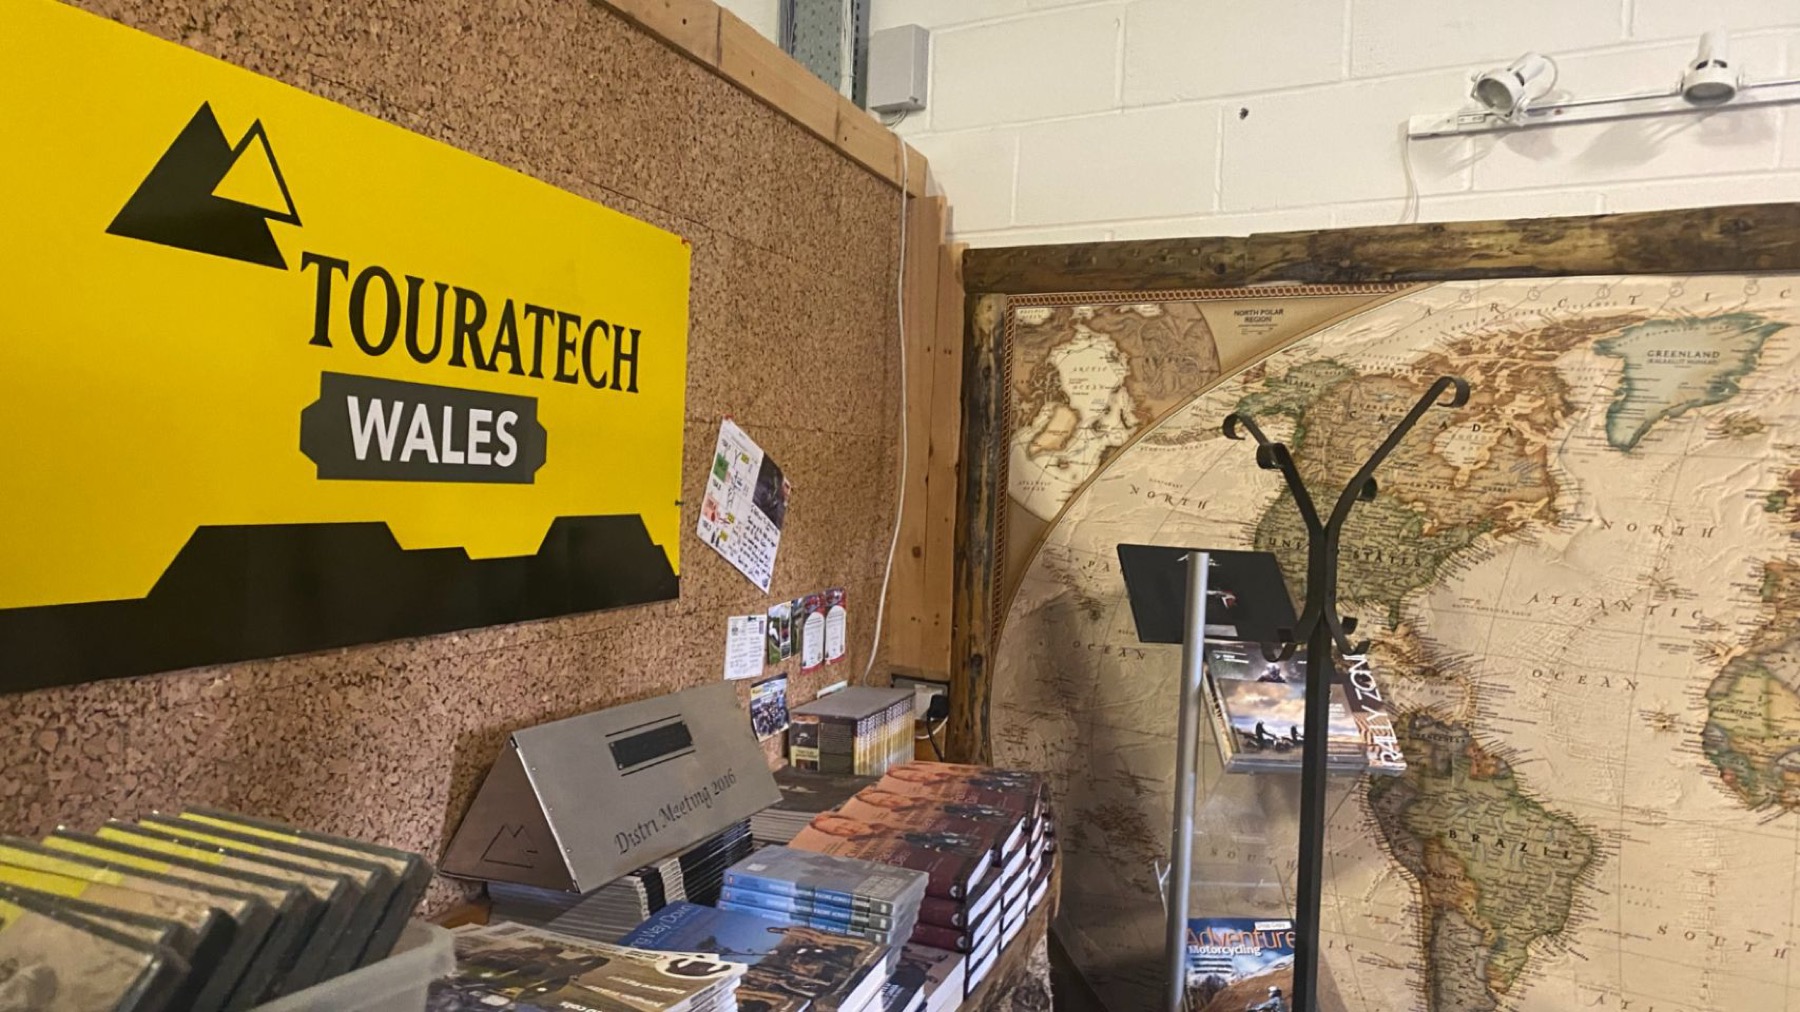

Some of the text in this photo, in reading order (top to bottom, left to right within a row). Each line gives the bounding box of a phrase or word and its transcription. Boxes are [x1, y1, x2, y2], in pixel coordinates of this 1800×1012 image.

[300, 251, 642, 394] TOURATECH
[1233, 308, 1284, 316] NORTH POLAR
[1647, 349, 1721, 359] GREENLAND
[346, 395, 519, 468] WALES
[1130, 483, 1208, 510] NORTH
[1601, 516, 1718, 539] NORTH
[1525, 593, 1703, 620] ATLANTIC
[1532, 668, 1640, 692] OCEAN
[614, 768, 737, 855] Distri Meeting 2016
[1449, 829, 1570, 859] BRAZIL
[646, 919, 671, 940] Way
[667, 903, 692, 925] Down
[1186, 926, 1296, 949] Adventure
[1188, 944, 1262, 956] Motorcycling
[1657, 922, 1789, 959] SOUTH
